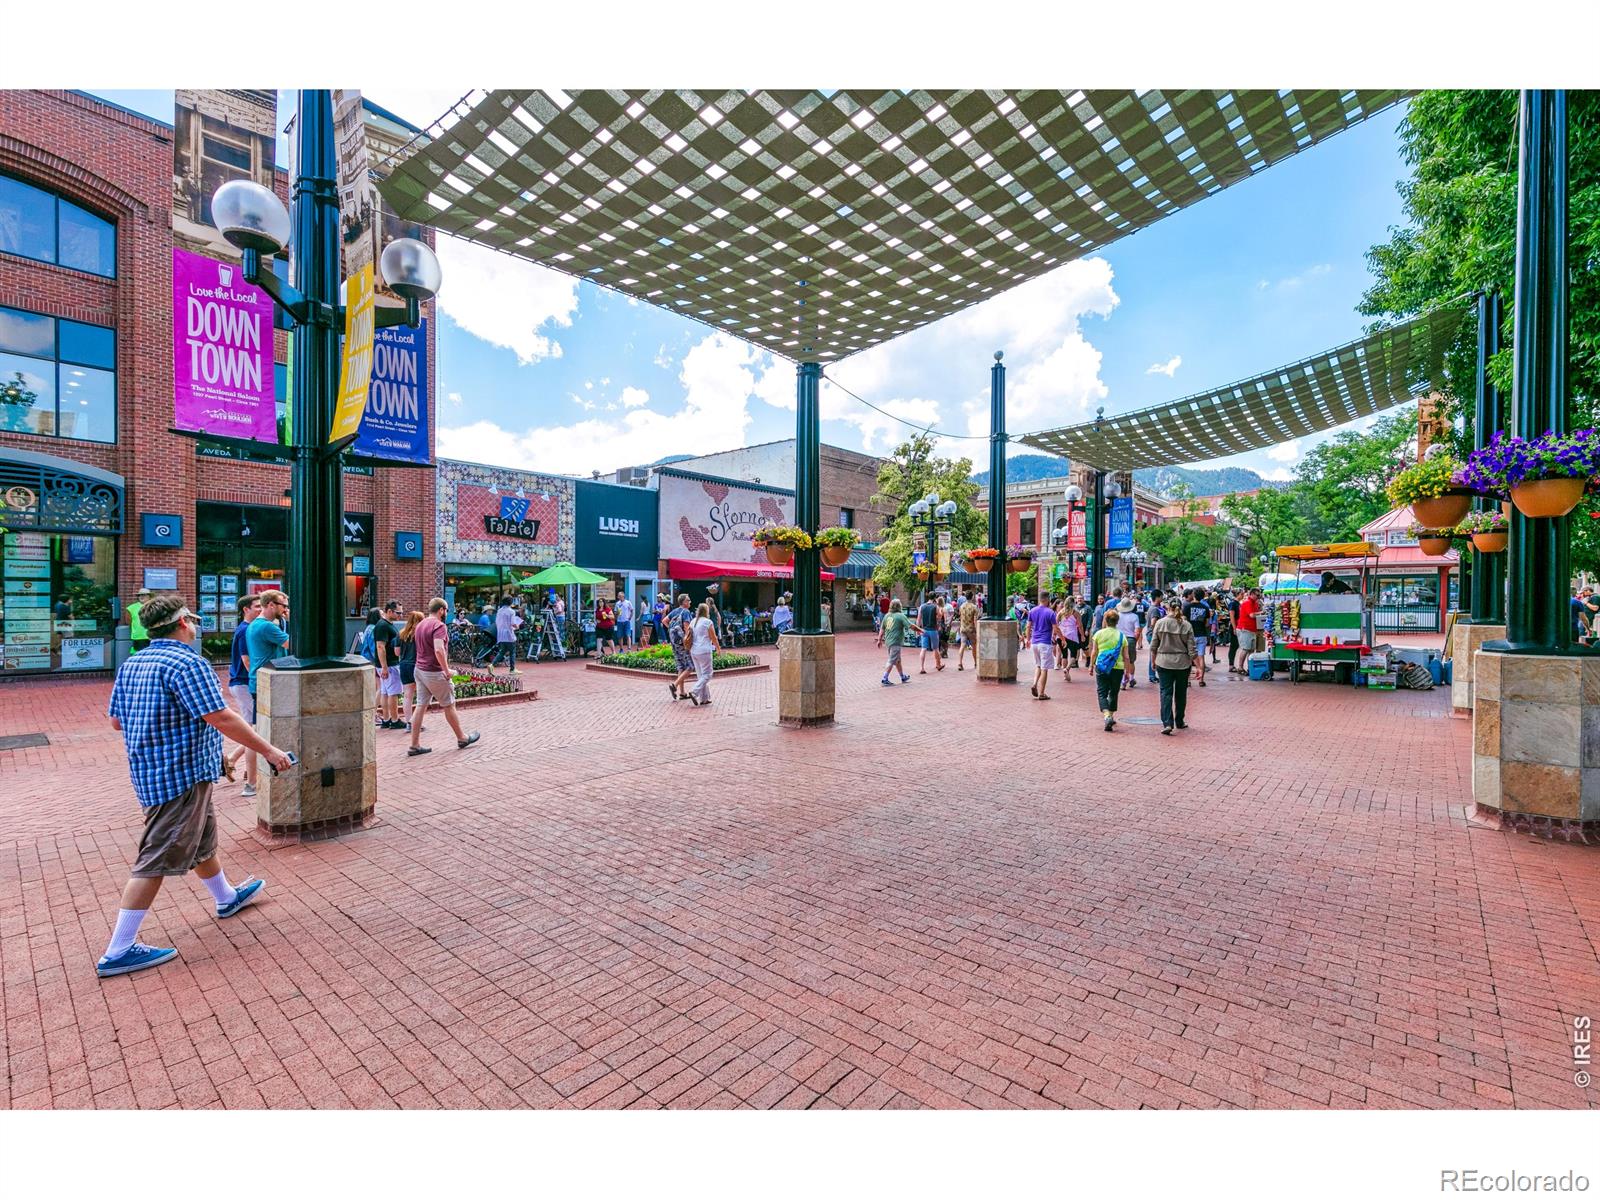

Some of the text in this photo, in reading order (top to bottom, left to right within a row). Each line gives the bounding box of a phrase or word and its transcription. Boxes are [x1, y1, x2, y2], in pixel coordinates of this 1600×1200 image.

[190, 282, 258, 305] Love the Local
[187, 296, 261, 351] DOWN
[382, 331, 393, 342] the
[394, 331, 415, 344] Local
[186, 338, 262, 393] TOWN
[372, 343, 417, 385] OWN
[190, 384, 260, 402] The National Saloon
[202, 447, 232, 457] AVEDA
[490, 517, 536, 538] Falafel
[599, 516, 640, 534] LUSH
[709, 503, 766, 542] Sforno
[1112, 522, 1130, 535] TOWN
